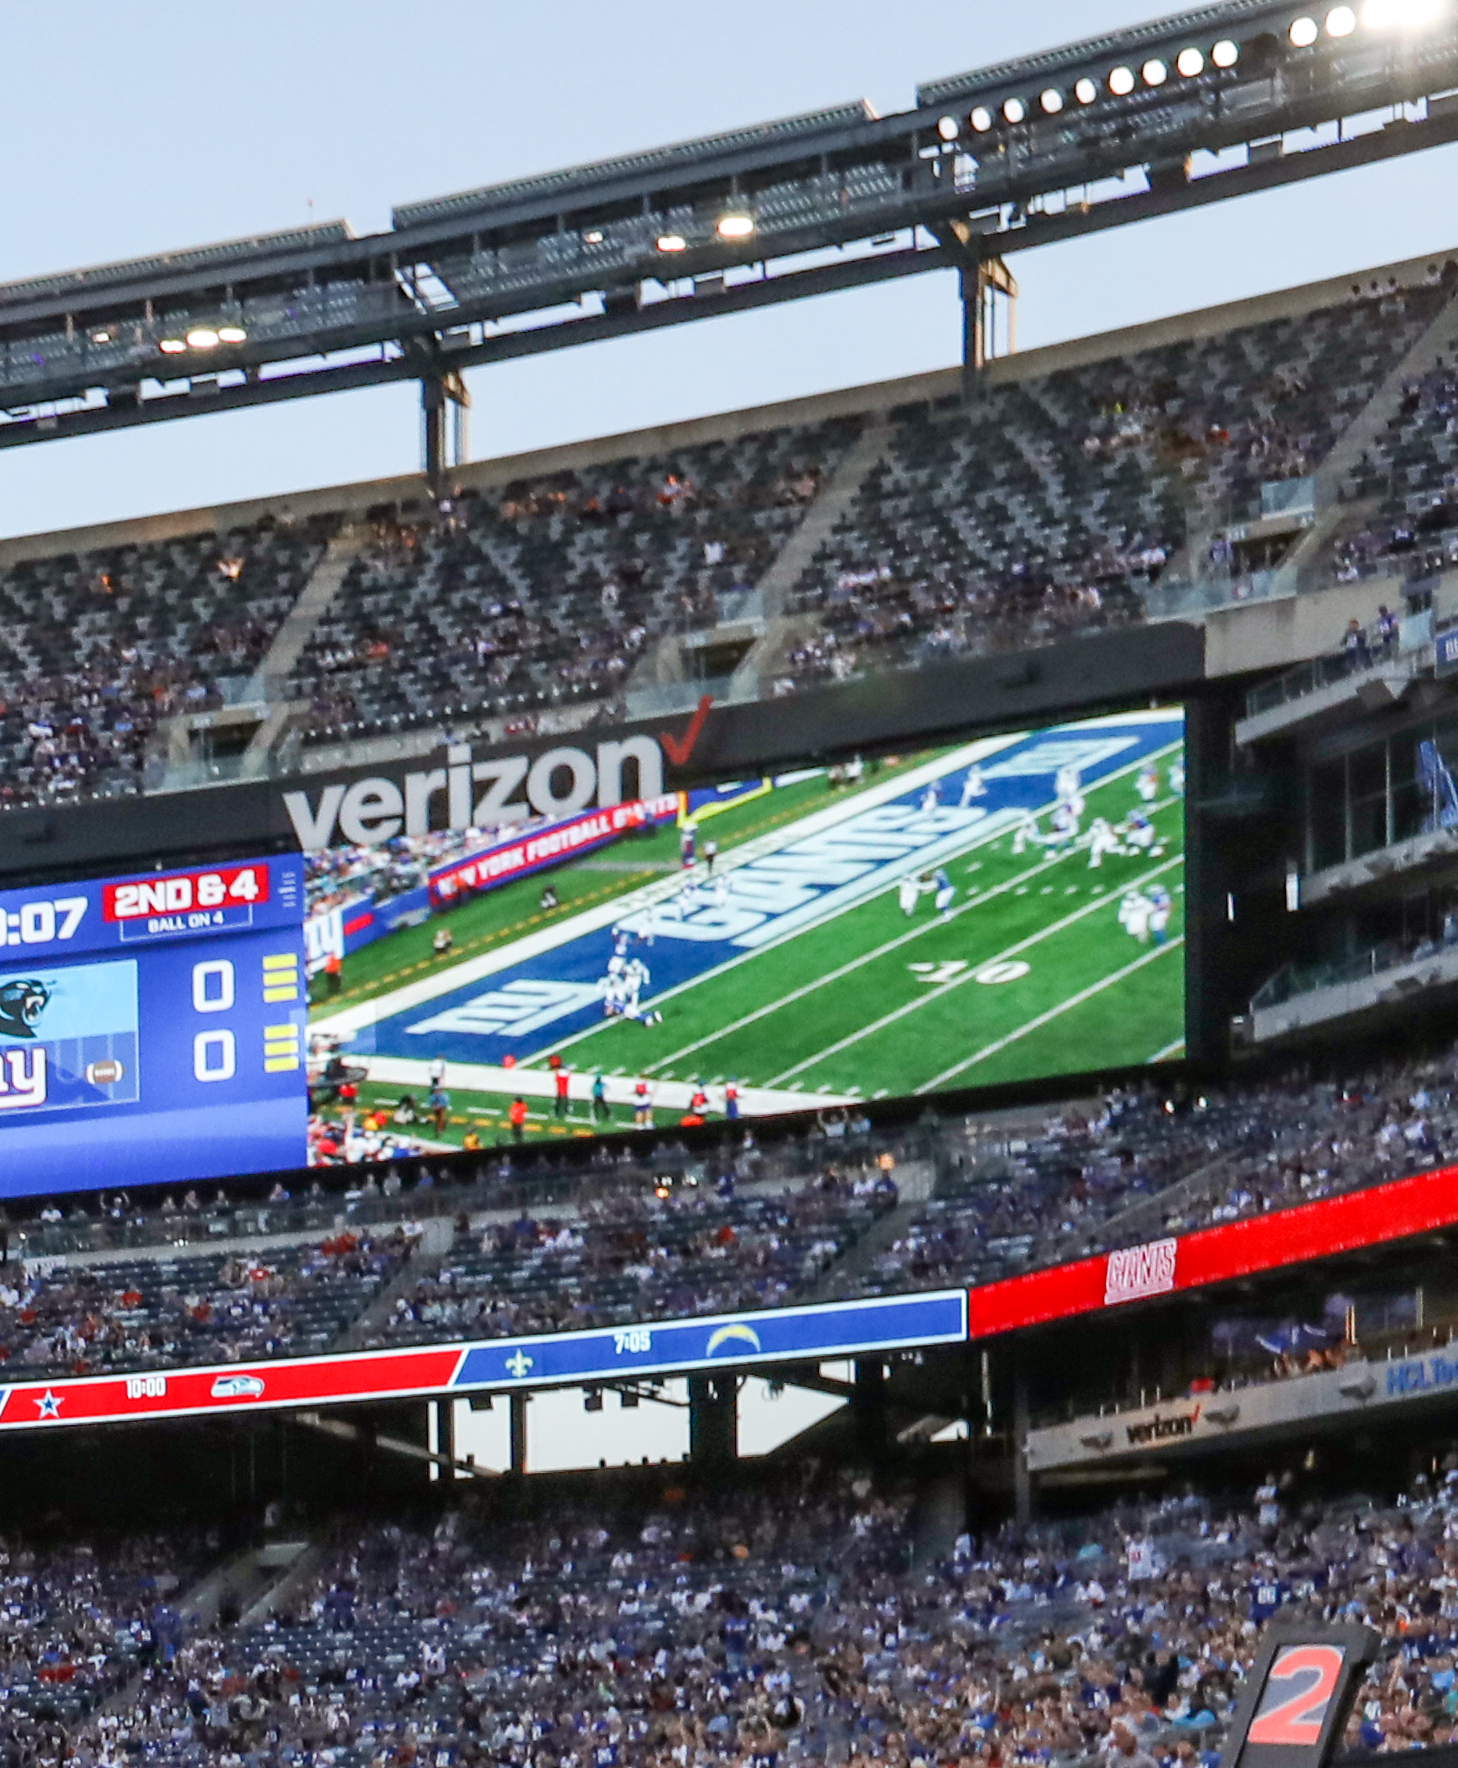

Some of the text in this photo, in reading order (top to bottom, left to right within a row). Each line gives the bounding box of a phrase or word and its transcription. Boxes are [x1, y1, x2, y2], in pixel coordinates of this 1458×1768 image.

[284, 727, 664, 849] verizon
[114, 879, 193, 918] 2ND
[197, 873, 226, 907] &
[229, 868, 259, 901] 4
[147, 910, 225, 935] BALL ON 4
[192, 958, 236, 1014] 0
[192, 1029, 237, 1083] 0
[1104, 1236, 1178, 1307] GIANTS
[126, 1376, 167, 1399] 10:00
[1125, 1415, 1193, 1449] verizon
[1247, 1644, 1345, 1745] 2
